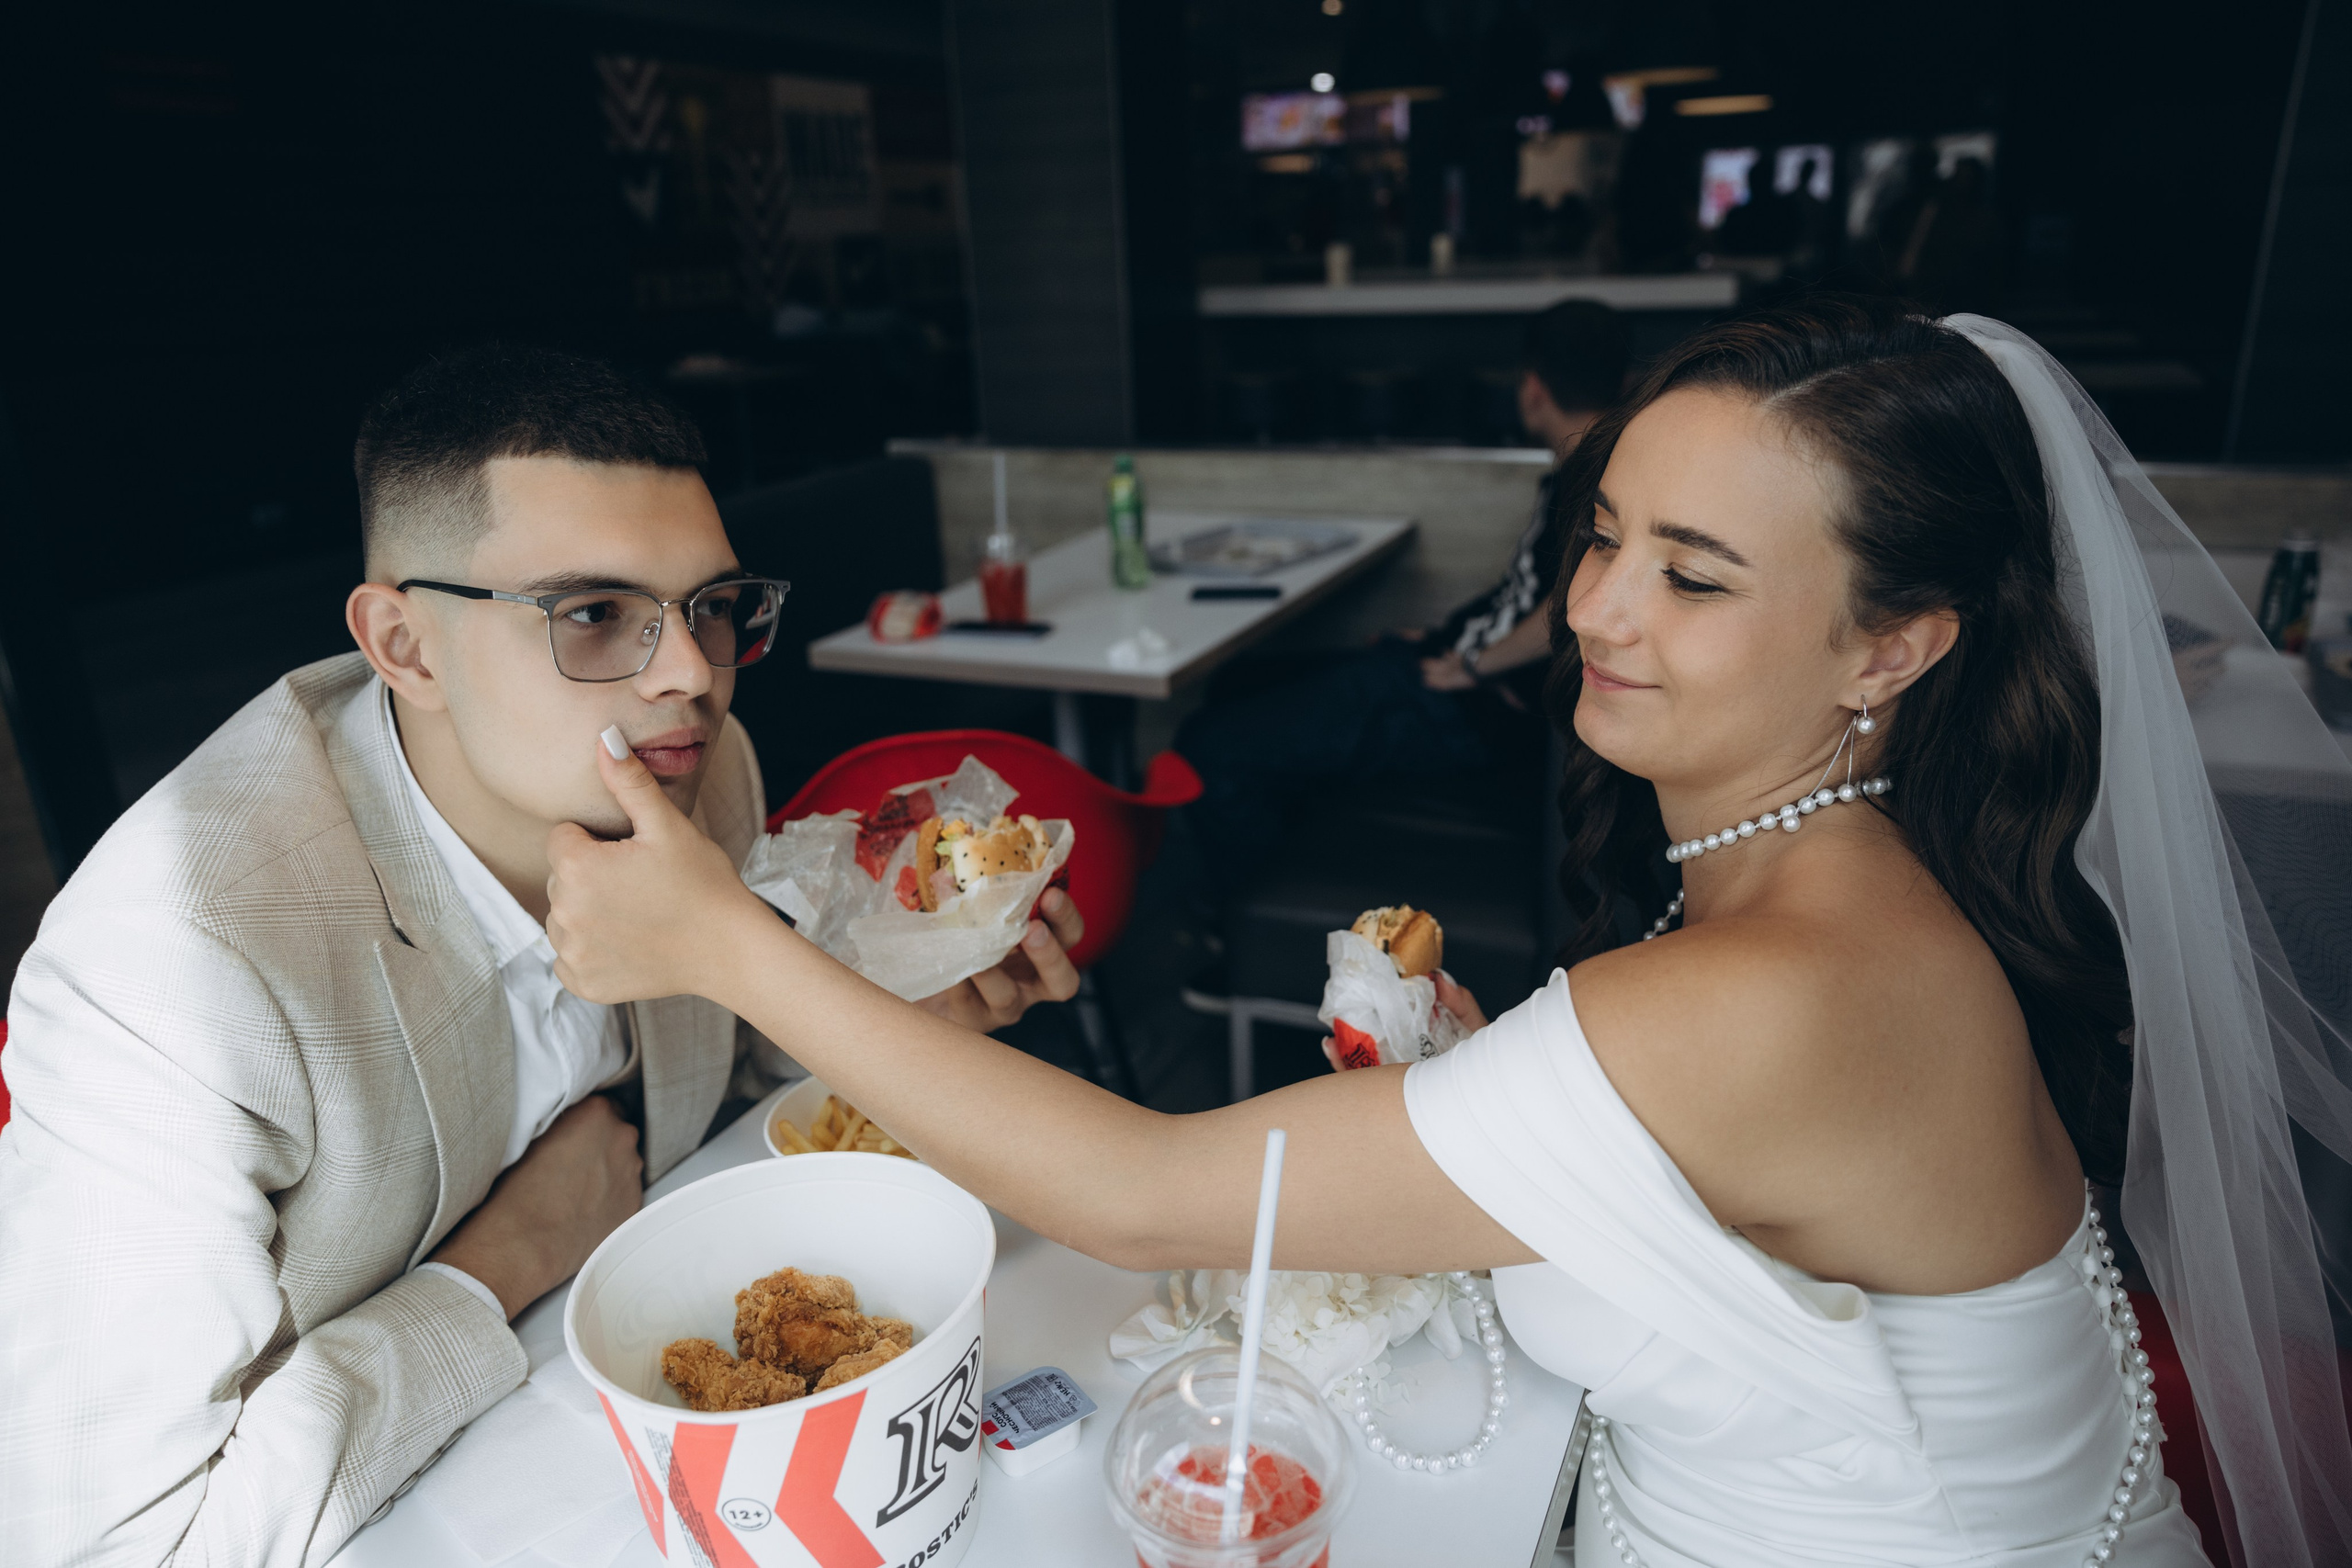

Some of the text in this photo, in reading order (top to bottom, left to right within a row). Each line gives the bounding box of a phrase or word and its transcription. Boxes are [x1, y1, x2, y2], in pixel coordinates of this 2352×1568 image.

[1055, 1381, 1070, 1396] HEINZ
[989, 1401, 1020, 1434] ЧЕСНОЧНЫЙ
[992, 1412, 1007, 1427] СОУС
[876, 1335, 981, 1529] R
[729, 1510, 763, 1520] 12+
[896, 1477, 978, 1568] OSTIC'S
